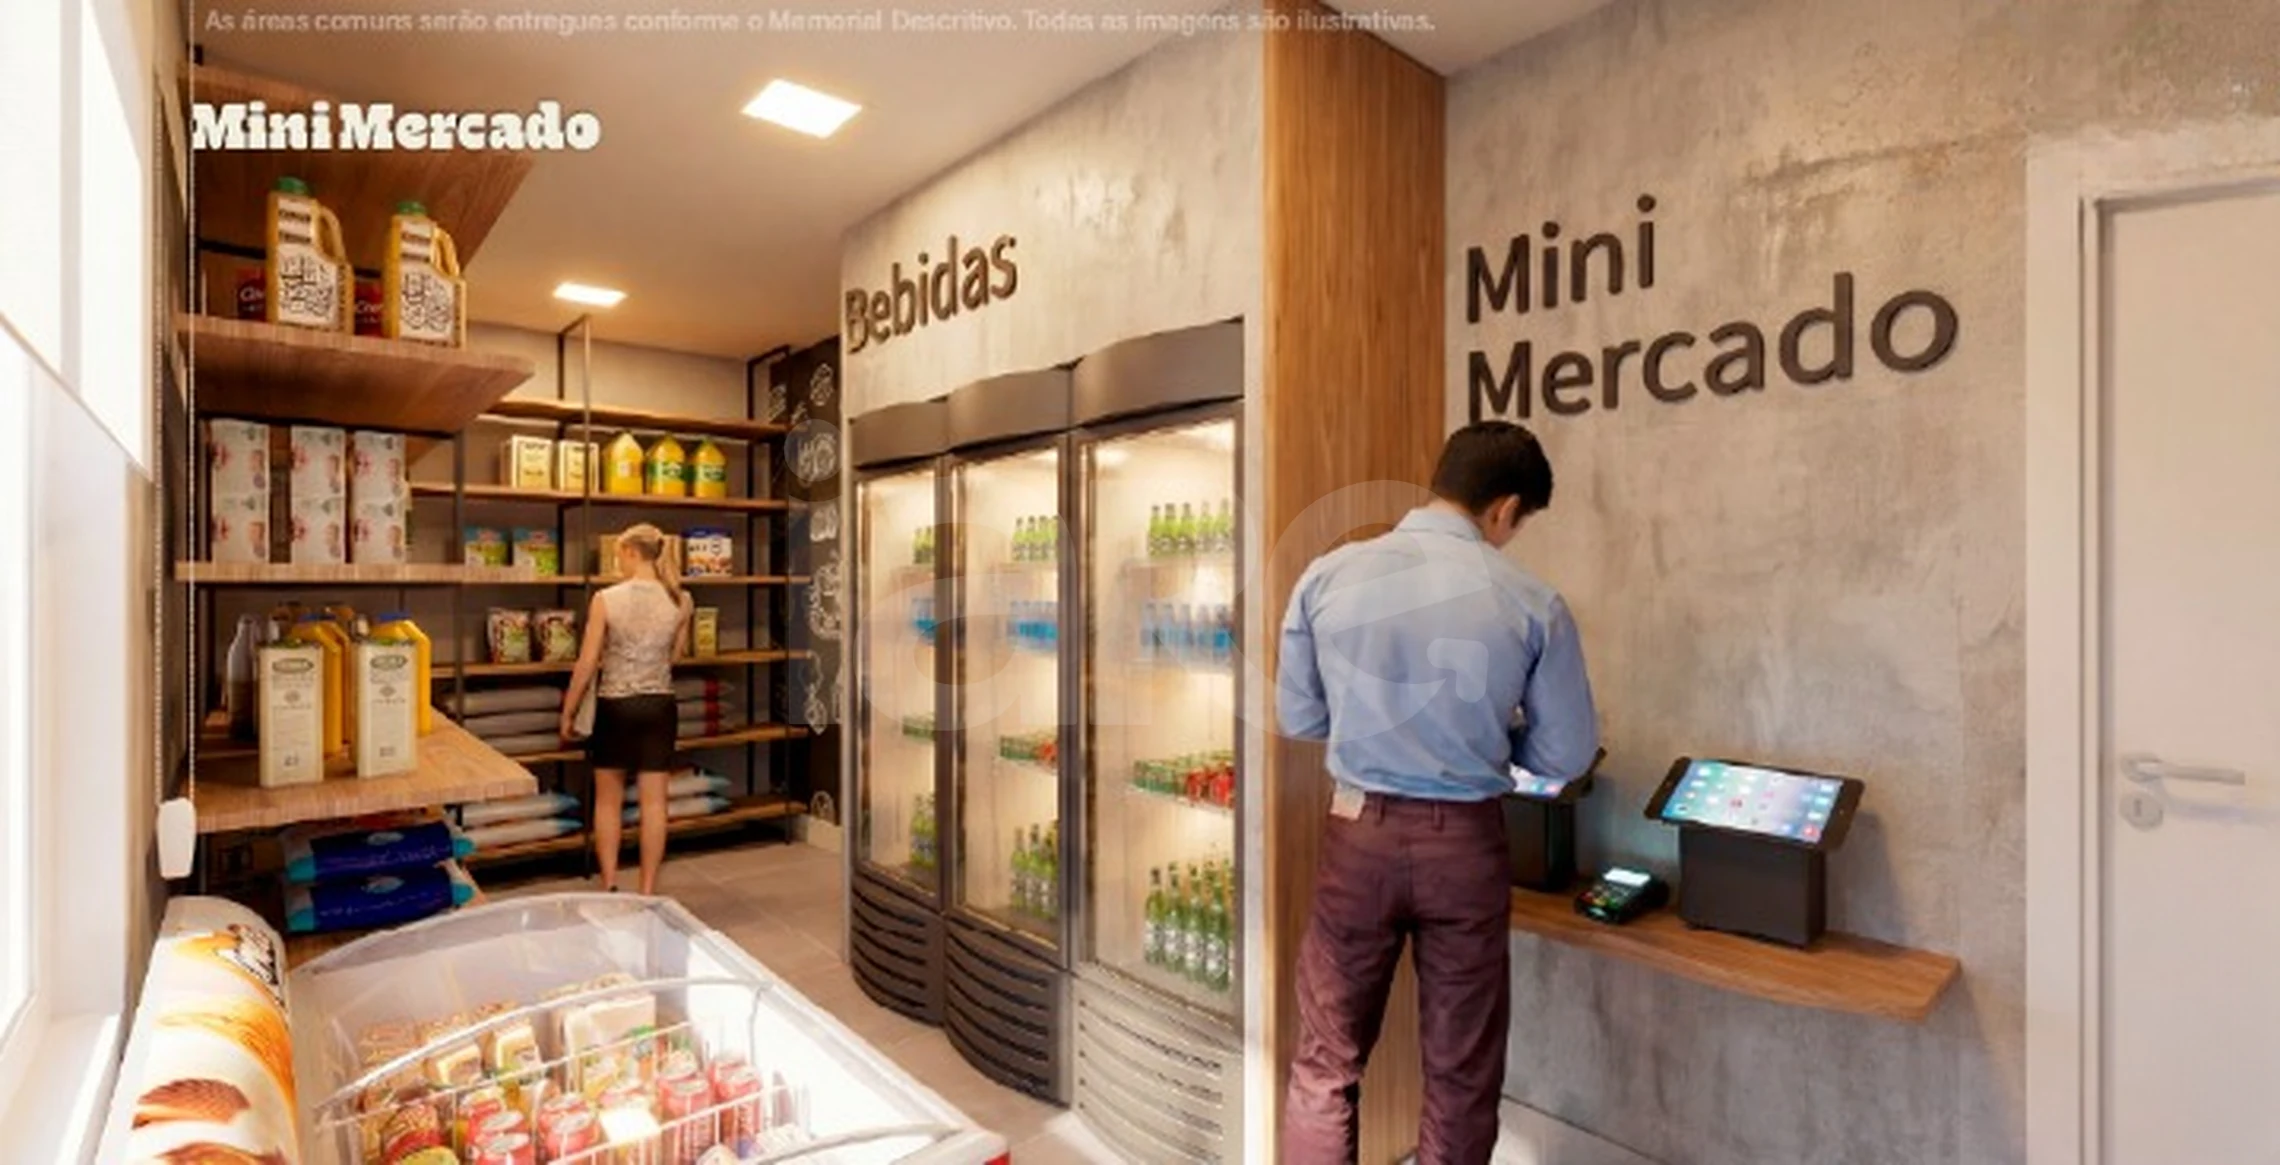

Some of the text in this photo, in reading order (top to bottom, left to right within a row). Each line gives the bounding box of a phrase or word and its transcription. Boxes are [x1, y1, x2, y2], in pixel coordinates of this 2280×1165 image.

[846, 234, 1018, 354] Bebidas
[1467, 193, 1657, 324] Mini
[1468, 271, 1959, 422] Mercado
